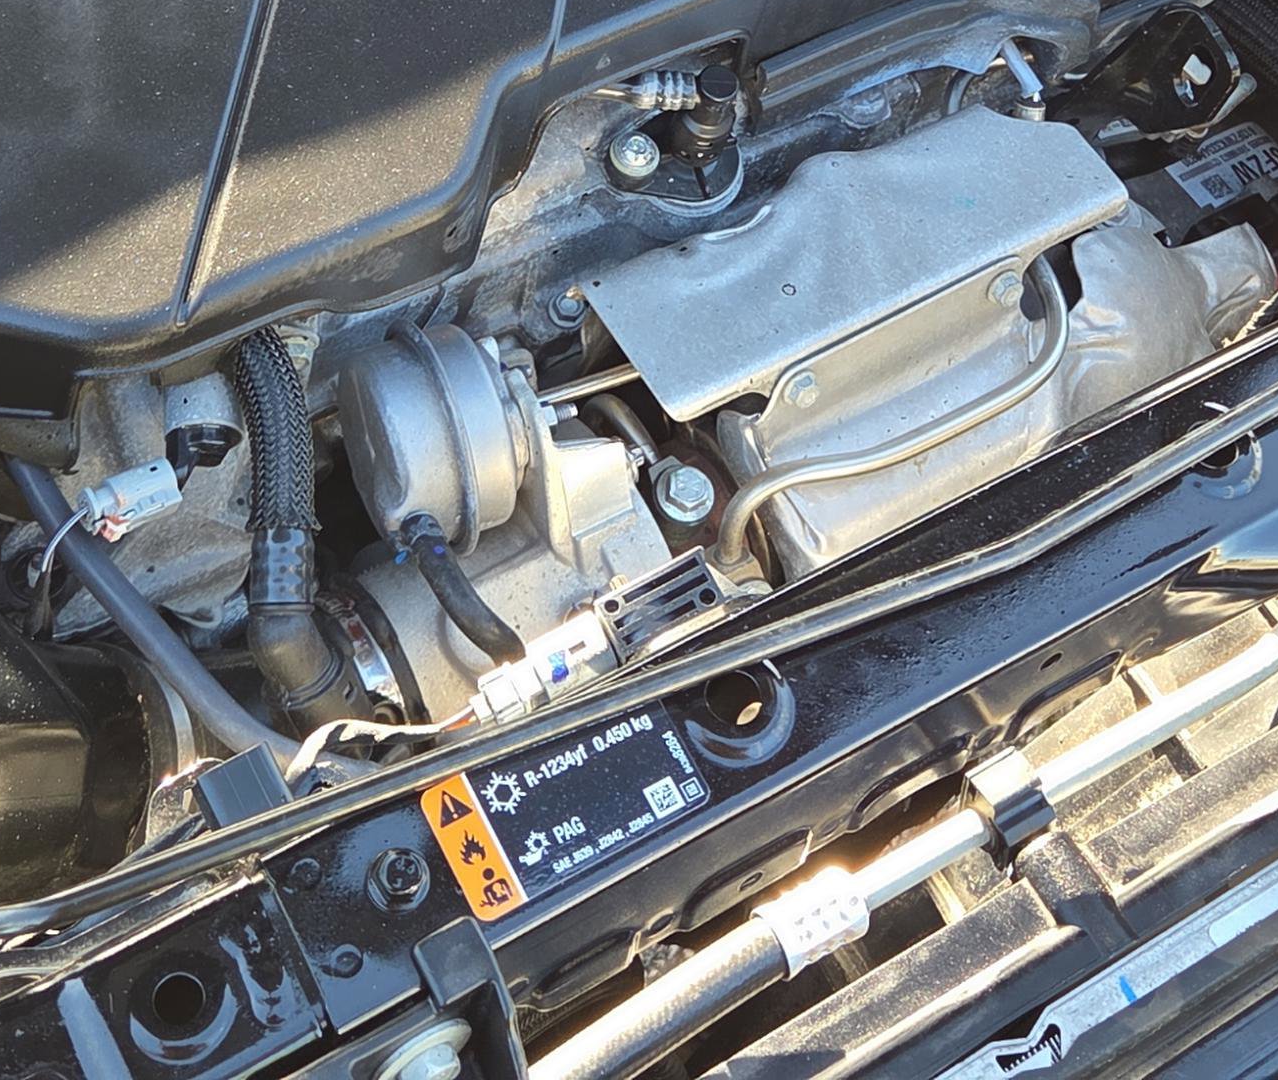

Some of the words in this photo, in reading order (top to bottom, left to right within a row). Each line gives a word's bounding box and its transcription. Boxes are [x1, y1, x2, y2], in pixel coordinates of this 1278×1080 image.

[522, 742, 589, 789] R-1234yf
[592, 722, 633, 753] 0.450
[630, 712, 654, 734] kg
[552, 815, 587, 845] PAG
[552, 857, 573, 874] SAE
